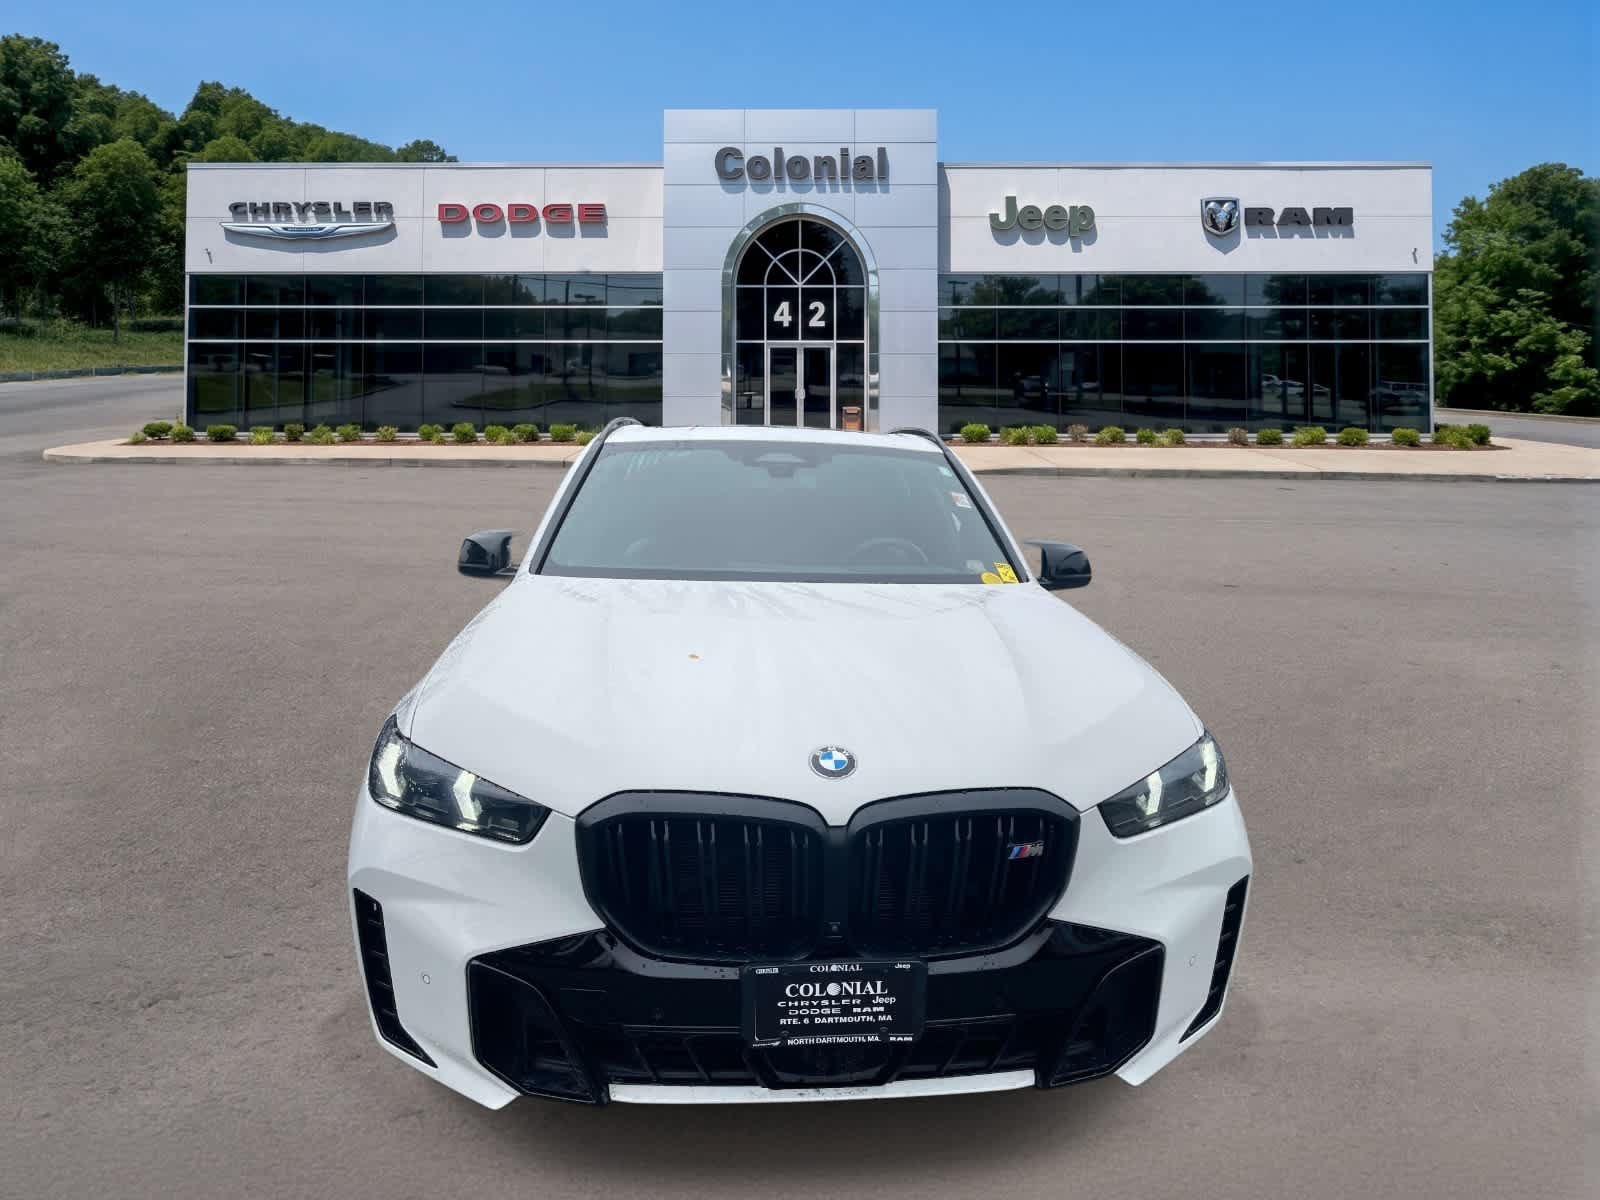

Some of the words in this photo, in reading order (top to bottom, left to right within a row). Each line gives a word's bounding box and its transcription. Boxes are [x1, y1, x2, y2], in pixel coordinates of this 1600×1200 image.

[714, 146, 889, 181] Colonial
[228, 201, 393, 217] CHRYSLER
[438, 203, 606, 224] DODGE
[989, 196, 1096, 237] Jeep
[1244, 207, 1354, 227] RAM
[809, 963, 863, 973] COLONIAL
[785, 980, 888, 998] COLONIAL
[777, 998, 862, 1007] CHRYSLER
[872, 995, 896, 1004] Jeep
[788, 1007, 841, 1016] DODGE
[803, 1017, 810, 1025] 6
[814, 1015, 876, 1025] DARTMOUTH,
[878, 1014, 893, 1022] MA
[787, 1037, 815, 1046] NORTH
